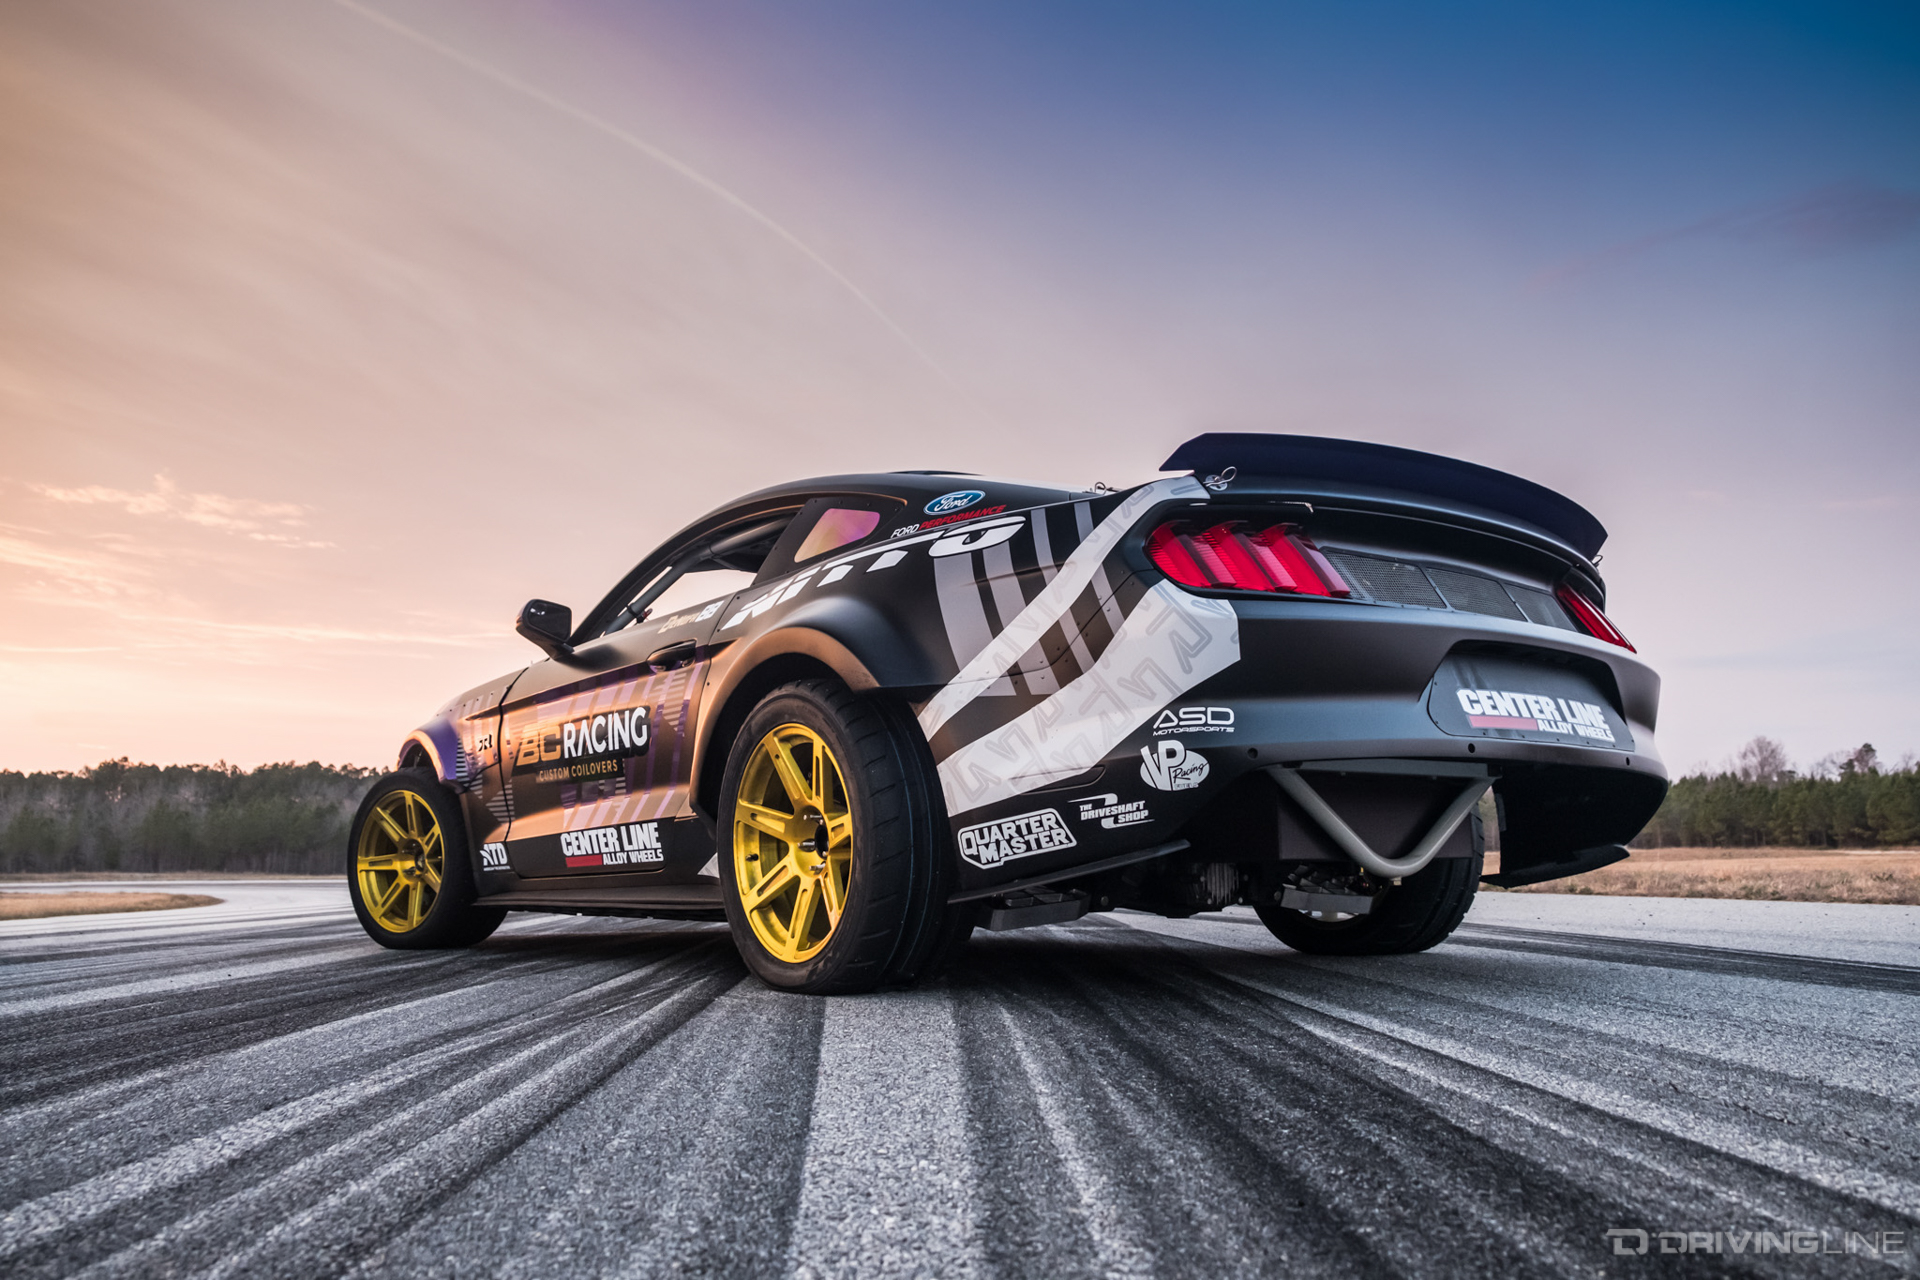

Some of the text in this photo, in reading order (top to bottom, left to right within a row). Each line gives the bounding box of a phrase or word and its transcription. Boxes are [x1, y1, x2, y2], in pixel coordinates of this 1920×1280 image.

[934, 493, 973, 511] Ford
[890, 504, 1007, 538] FORD PERFORMANCE
[1153, 707, 1235, 729] ASD
[1456, 688, 1610, 729] CENTER LINE
[515, 707, 648, 766] BC RACING
[1153, 726, 1235, 736] MOTORSPORTS
[1537, 719, 1615, 743] ALLOY WHEELS
[539, 759, 618, 782] CUSTOM COILOVERS
[1140, 740, 1186, 791] VP
[1172, 763, 1209, 784] Racing
[1080, 803, 1092, 811] THE
[1081, 800, 1146, 821] DRIVESHAFT
[1118, 809, 1149, 823] SHOP
[560, 822, 662, 856] CENTER LINE
[960, 813, 1060, 856] QUARTER
[978, 828, 1070, 864] MASTER
[603, 849, 664, 866] ALLOY WHEELS
